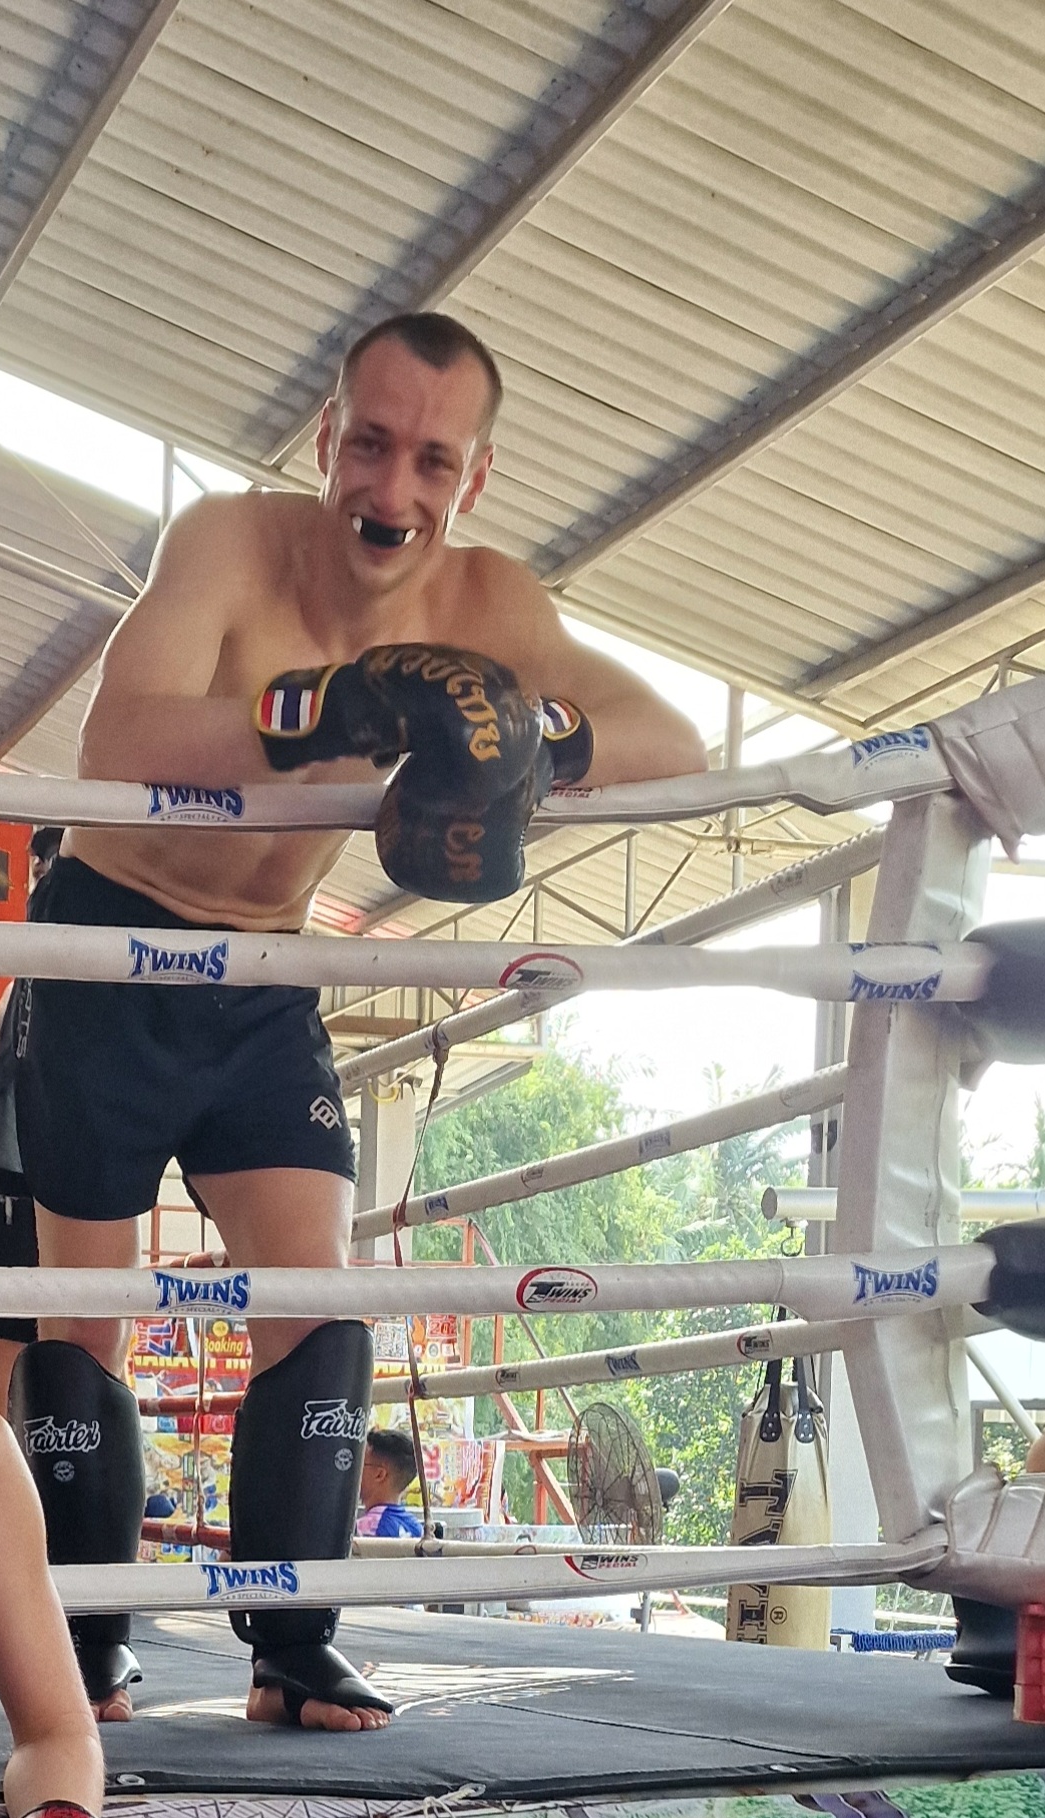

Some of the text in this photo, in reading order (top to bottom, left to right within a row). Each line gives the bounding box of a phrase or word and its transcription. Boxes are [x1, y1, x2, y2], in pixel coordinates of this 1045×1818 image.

[129, 938, 228, 982] TWINS
[154, 1270, 250, 1311] TWINS
[853, 1257, 940, 1304] TWINS
[23, 1416, 101, 1457] Fairtex
[301, 1399, 368, 1443] Fairte
[201, 1562, 301, 1598] TWINS
